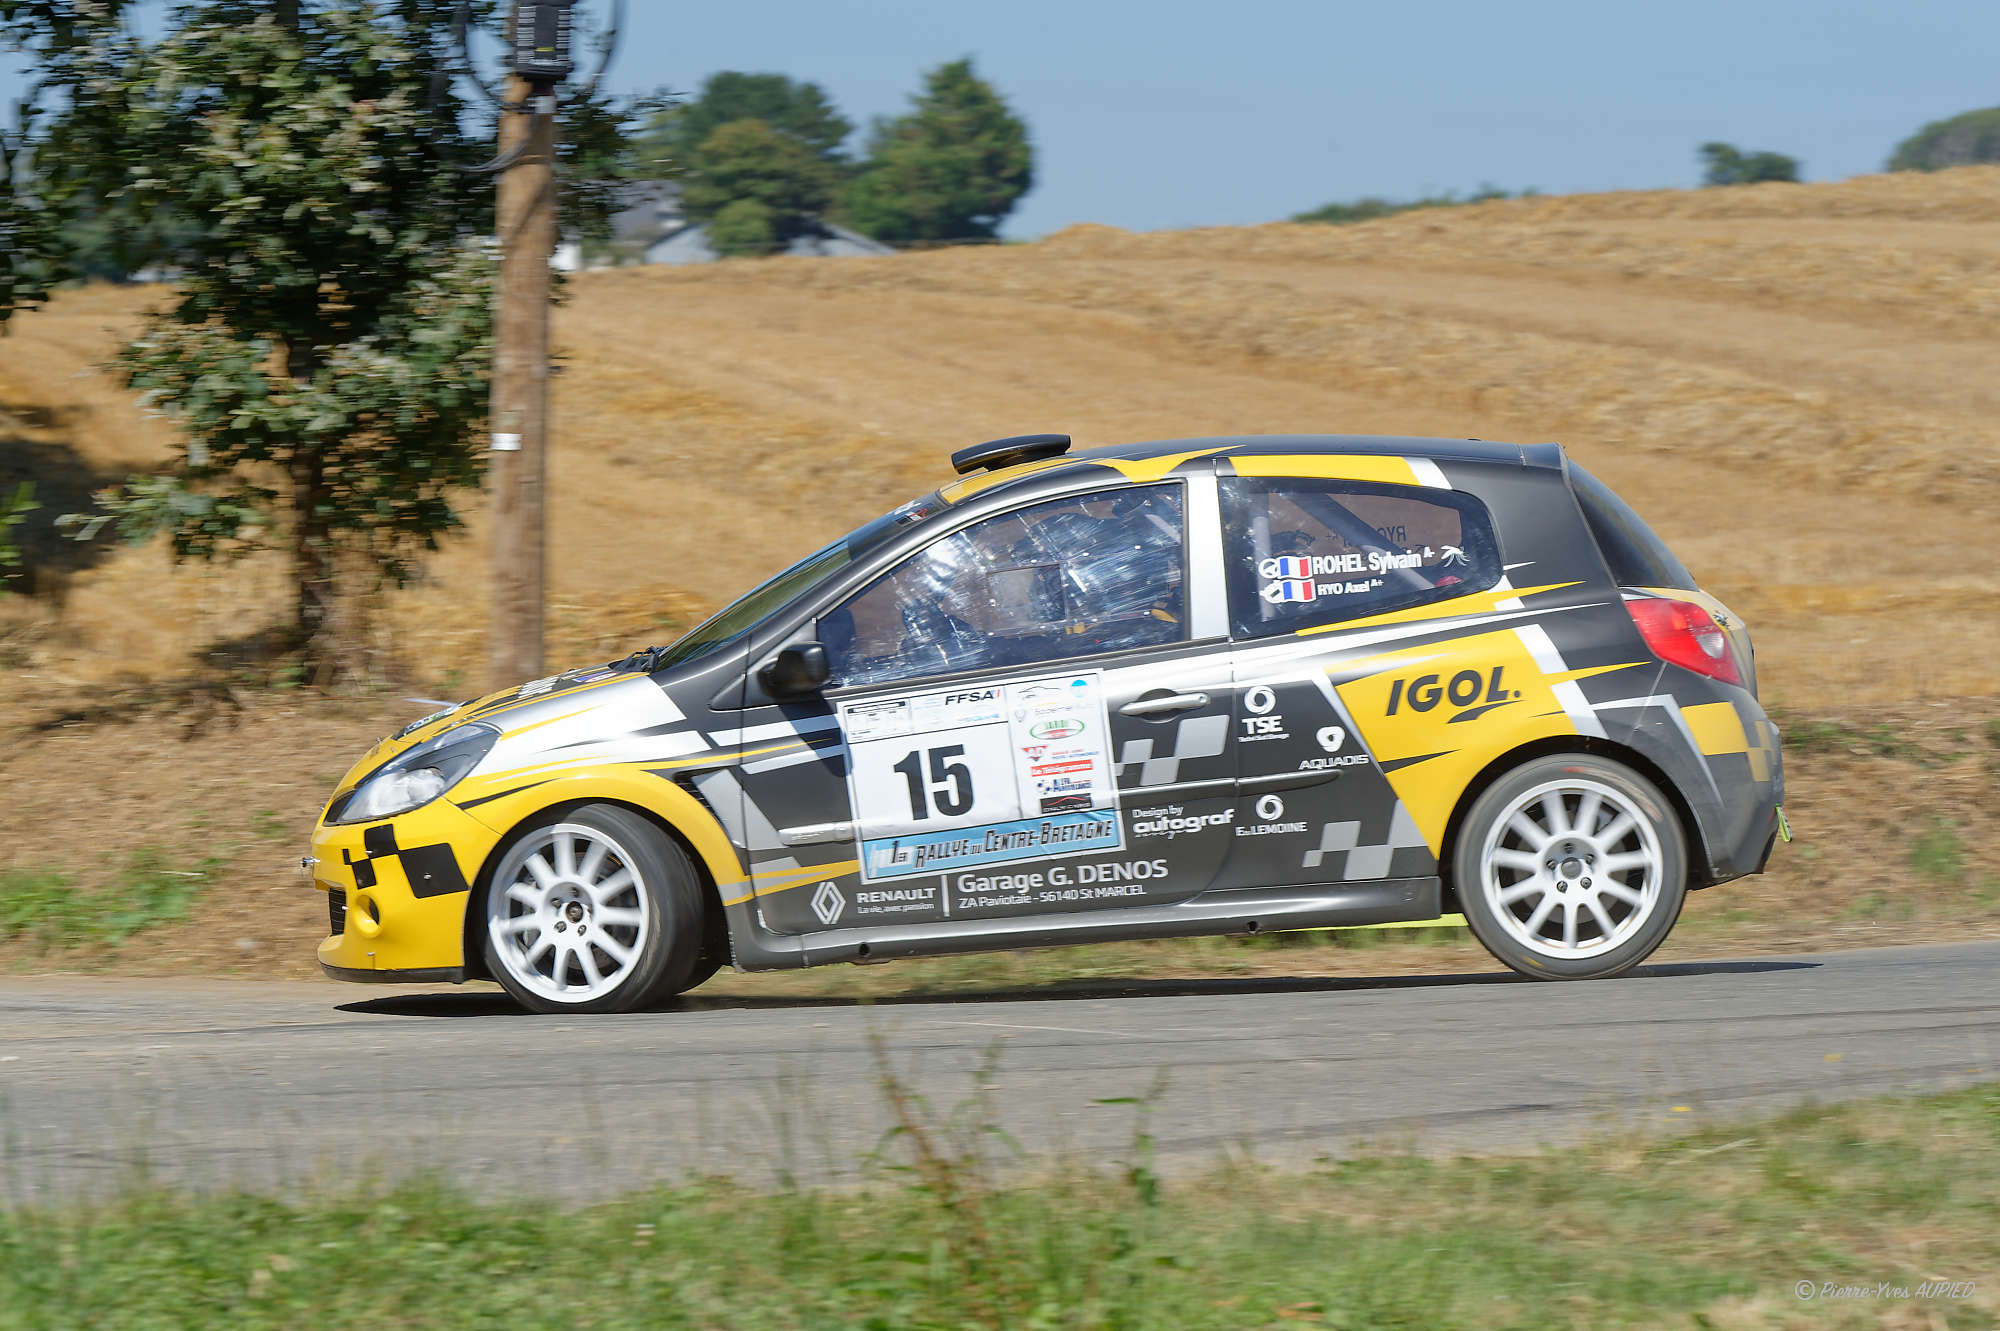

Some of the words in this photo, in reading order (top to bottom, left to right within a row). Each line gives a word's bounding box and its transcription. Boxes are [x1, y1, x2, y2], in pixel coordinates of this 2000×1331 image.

[1312, 554, 1367, 575] ROHEL
[1368, 549, 1422, 575] Sylvain
[1317, 582, 1344, 596] RYO
[1344, 580, 1370, 594] Axel
[945, 690, 994, 706] FFSA
[1241, 715, 1283, 735] TSE
[1298, 754, 1369, 770] AQUADIS
[893, 744, 975, 820] 15
[1132, 807, 1168, 818] Design
[1168, 804, 1184, 816] by
[1133, 808, 1236, 834] autograf
[957, 872, 1044, 894] Garage
[1047, 866, 1074, 886] G.
[1077, 859, 1169, 884] DENOS
[856, 887, 937, 903] RENAULT
[958, 897, 978, 909] ZA
[1039, 888, 1079, 903] 56140
[1079, 888, 1094, 899] St
[1094, 884, 1148, 898] MARCEL
